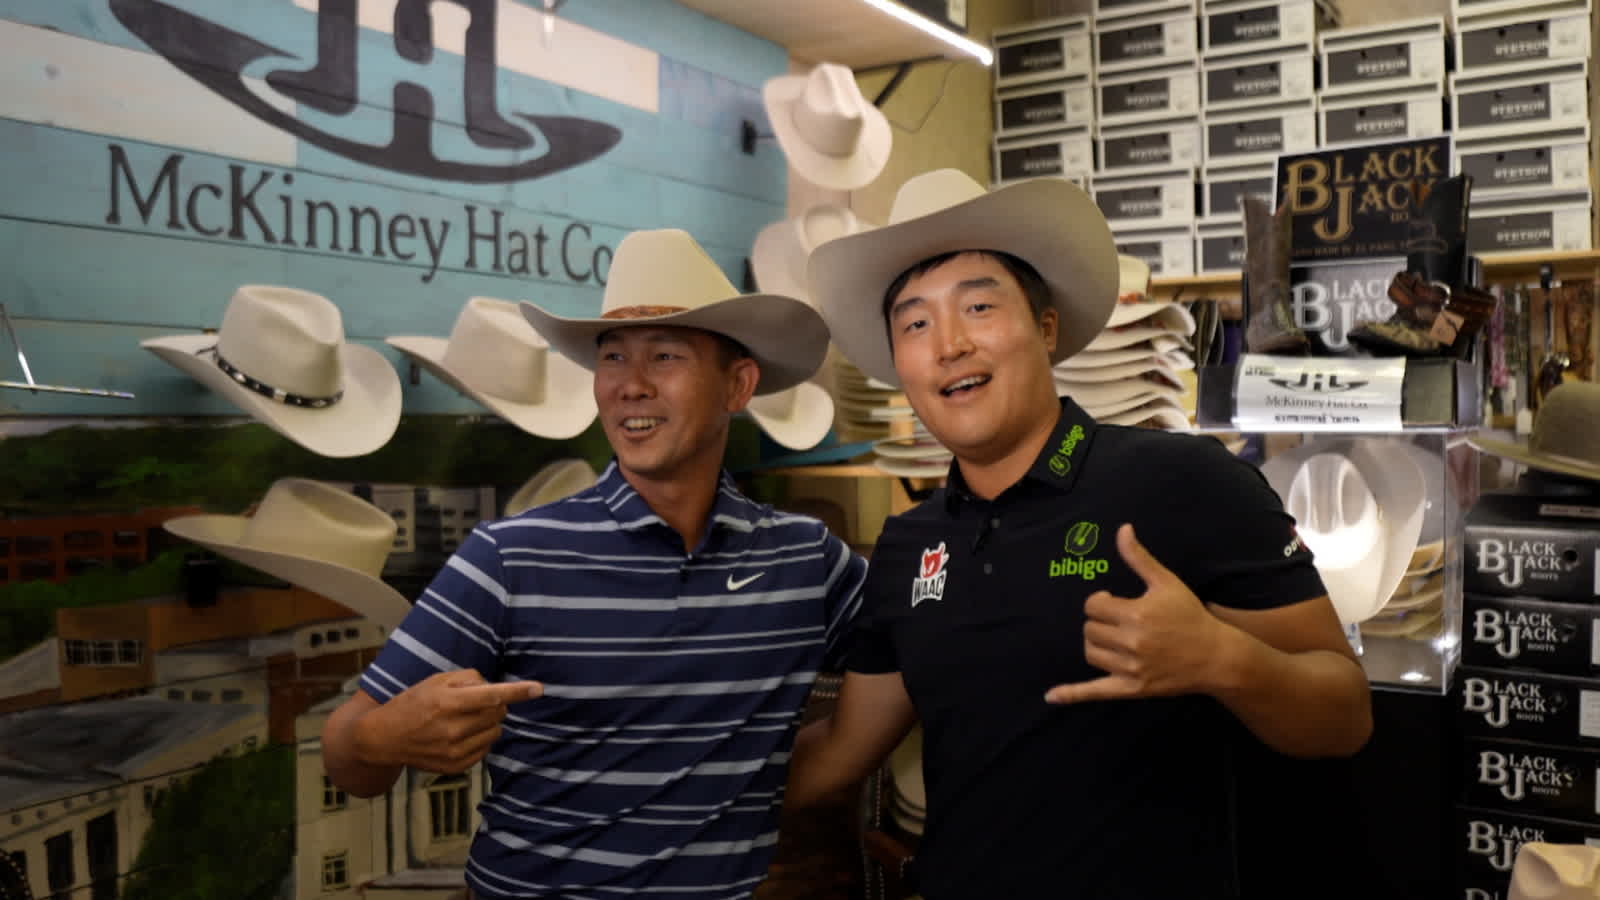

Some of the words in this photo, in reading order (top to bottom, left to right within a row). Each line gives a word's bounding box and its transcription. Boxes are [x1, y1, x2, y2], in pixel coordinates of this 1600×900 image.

[105, 143, 451, 283] McKinney
[463, 204, 550, 278] Hat
[1312, 178, 1436, 243] JAC
[1050, 557, 1109, 580] bibigo
[1476, 539, 1557, 573] BLACK
[1498, 555, 1562, 588] JACK
[912, 572, 946, 604] WAAC
[1473, 608, 1554, 643] BLACK
[1495, 624, 1560, 659] JACK
[1462, 677, 1542, 713] BLACK
[1484, 694, 1547, 728] JACK
[1477, 750, 1558, 785] BLACK
[1499, 767, 1565, 800] JACK
